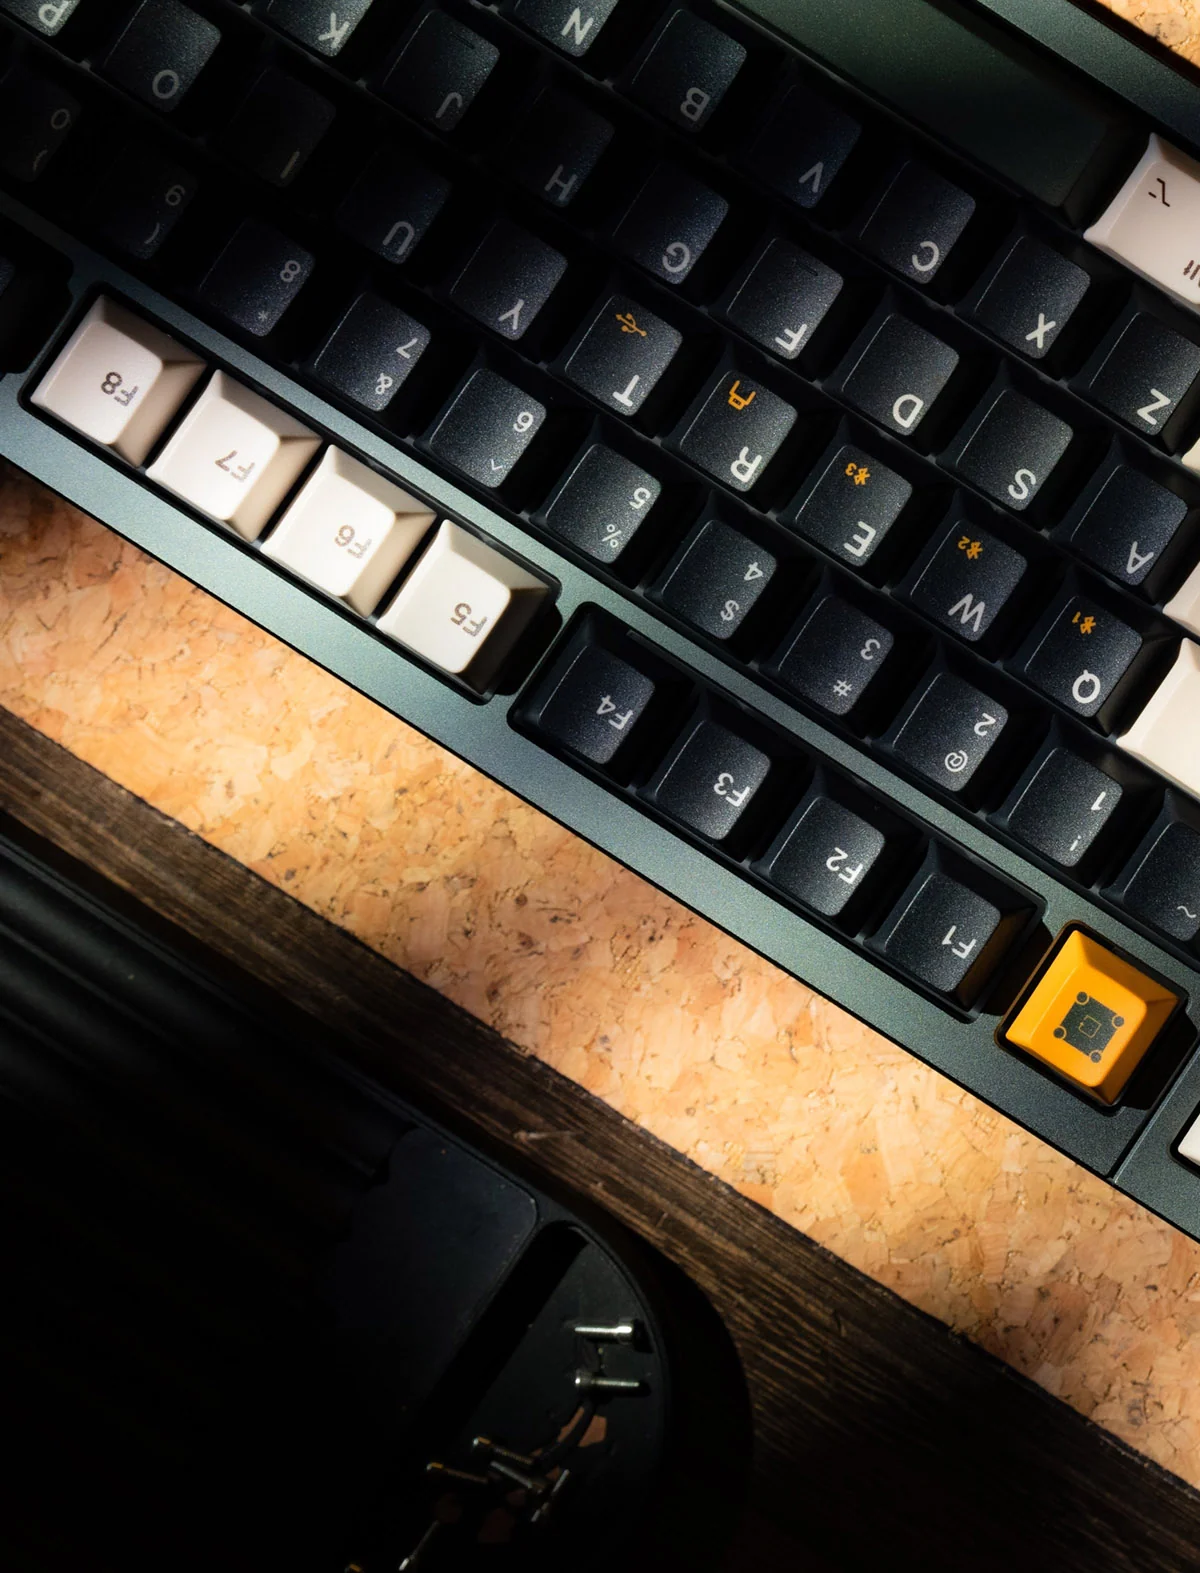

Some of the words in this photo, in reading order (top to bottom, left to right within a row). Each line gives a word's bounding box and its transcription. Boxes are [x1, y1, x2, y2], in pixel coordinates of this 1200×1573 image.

[39, 0, 68, 27] P
[562, 8, 594, 44] N
[319, 13, 350, 48] K
[153, 70, 180, 98] O
[436, 92, 462, 117] J
[681, 87, 710, 121] B
[545, 166, 577, 201] H
[799, 162, 823, 193] V
[165, 185, 185, 206] 9
[383, 222, 414, 255] U
[280, 261, 301, 282] 8
[663, 243, 690, 275] G
[913, 242, 939, 271] C
[499, 300, 524, 331] Y
[1026, 314, 1056, 348] X
[396, 338, 417, 359] 7
[775, 324, 807, 352] F
[101, 372, 136, 404] F8
[613, 375, 644, 407] T
[514, 412, 533, 432] 6
[893, 394, 923, 428] D
[1137, 389, 1171, 425] Z
[215, 450, 254, 480] F7
[731, 447, 762, 483] R
[630, 488, 651, 509] 5
[1008, 469, 1036, 500] S
[335, 525, 370, 558] F6
[844, 521, 876, 557] E
[744, 562, 763, 580] 4
[1127, 542, 1154, 573] A
[450, 602, 490, 639] F5
[949, 594, 985, 632] W
[861, 639, 880, 660] 3
[1073, 670, 1100, 703] Q
[597, 696, 633, 730] F4
[974, 713, 996, 736] 2
[714, 773, 750, 807] F3
[1091, 792, 1106, 810] 1
[827, 848, 863, 884] F2
[942, 926, 976, 959] F1
